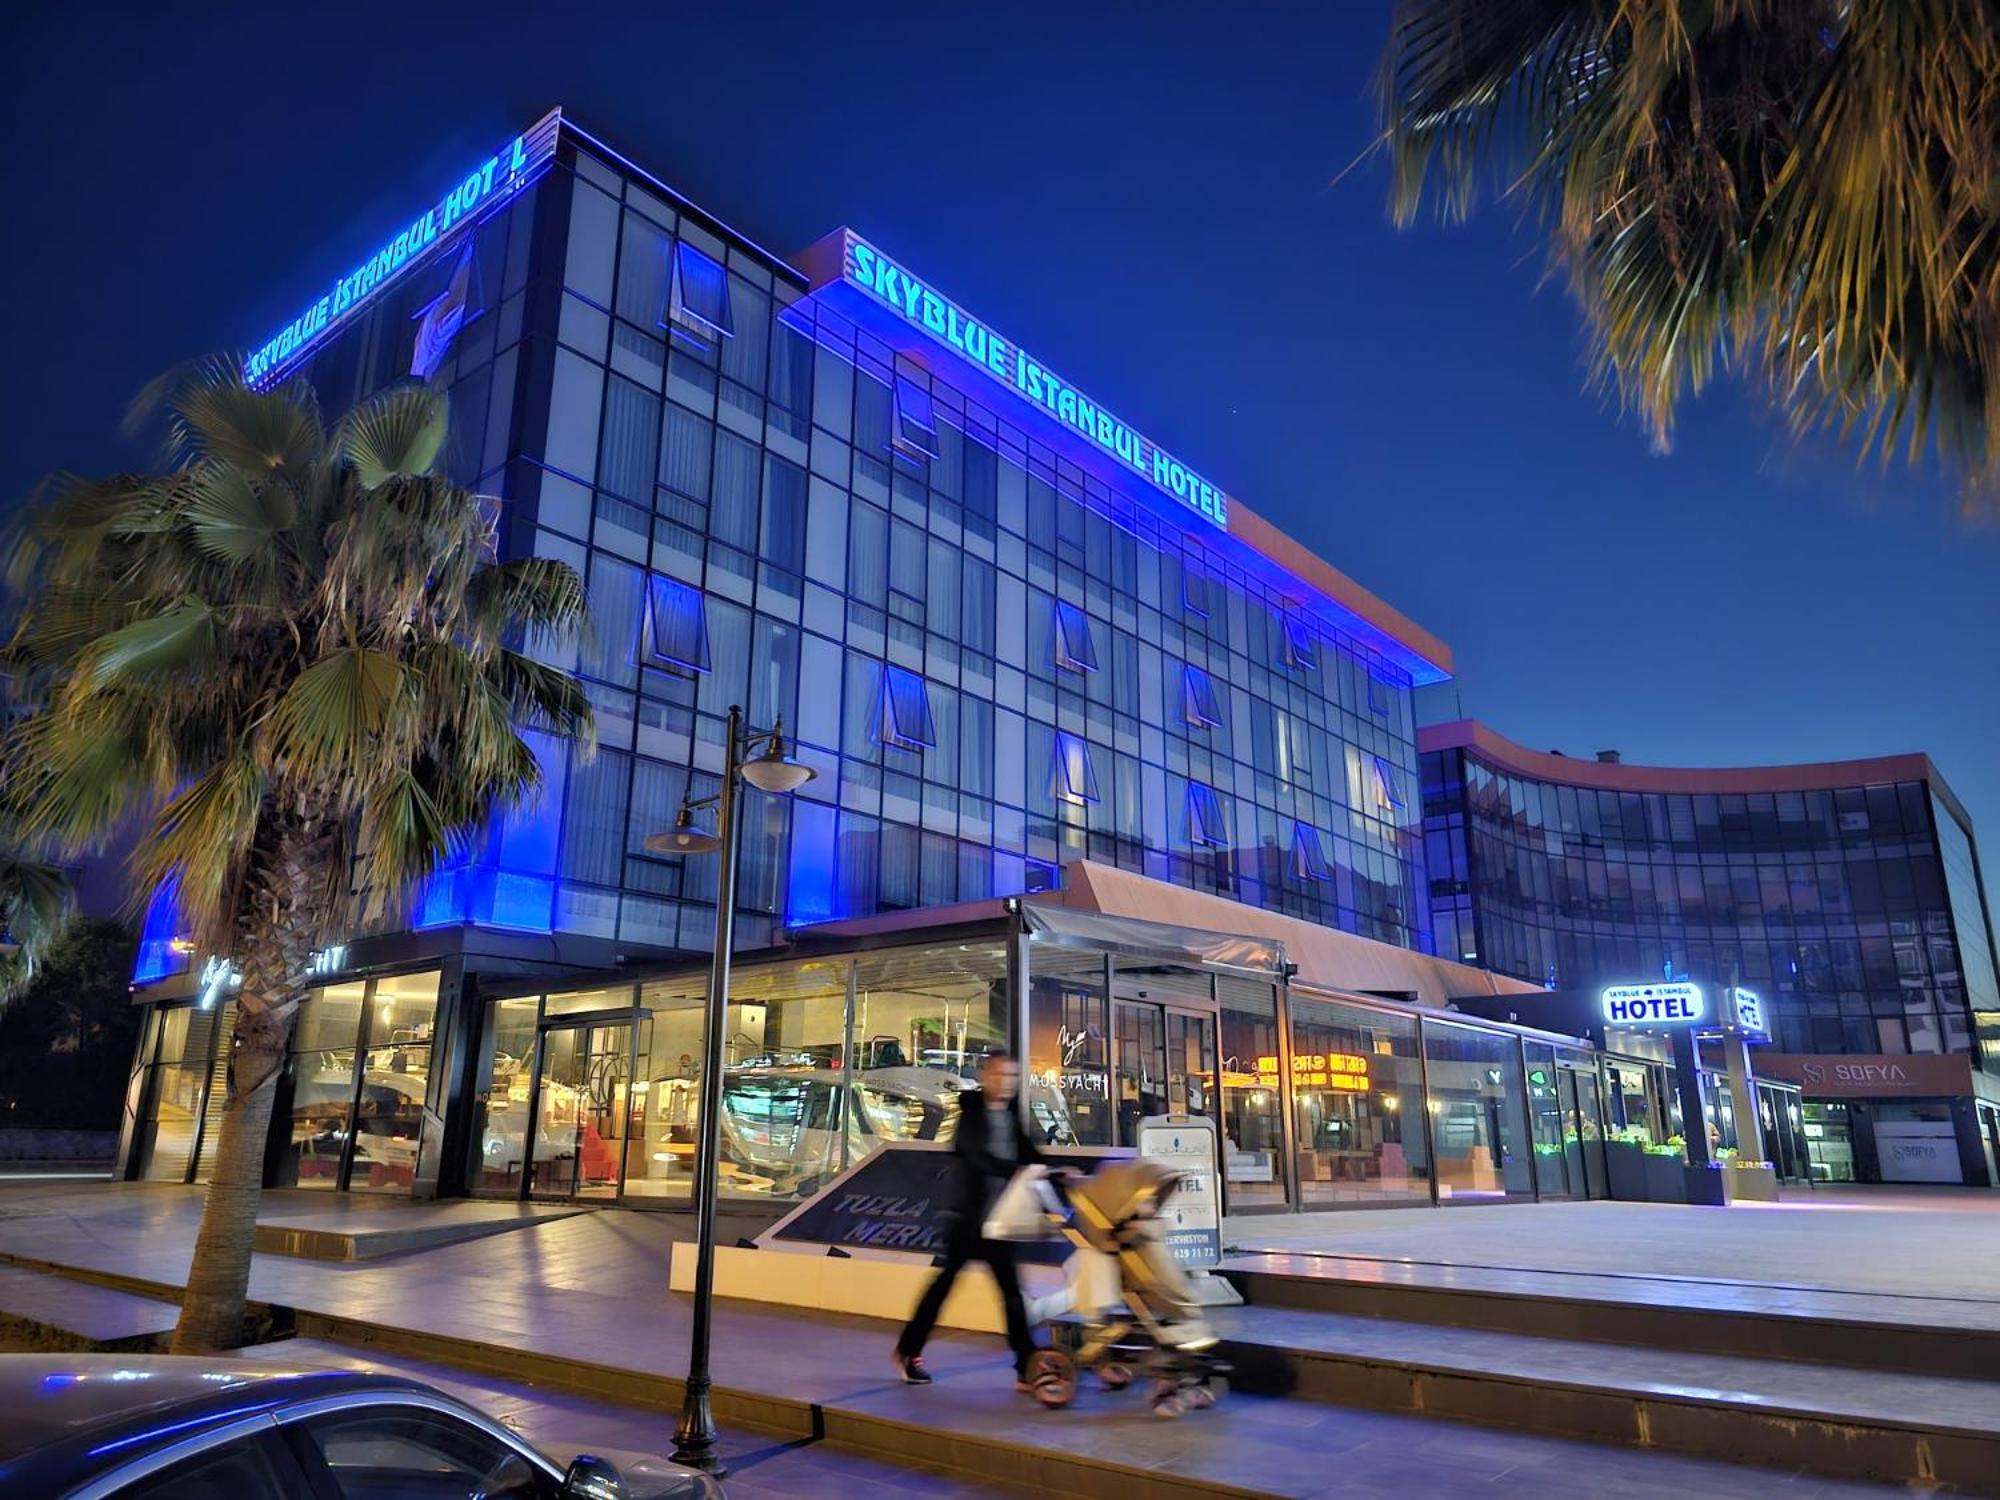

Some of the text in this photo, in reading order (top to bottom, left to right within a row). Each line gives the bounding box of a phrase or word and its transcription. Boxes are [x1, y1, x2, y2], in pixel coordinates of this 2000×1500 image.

[250, 296, 329, 378] SKYBLUE
[855, 244, 1226, 525] SKYBLUE İSTANBUL HOTEL
[1611, 998, 1694, 1020] HOTEL
[1835, 1064, 1906, 1081] SOFYA
[833, 1194, 930, 1217] TUZLA
